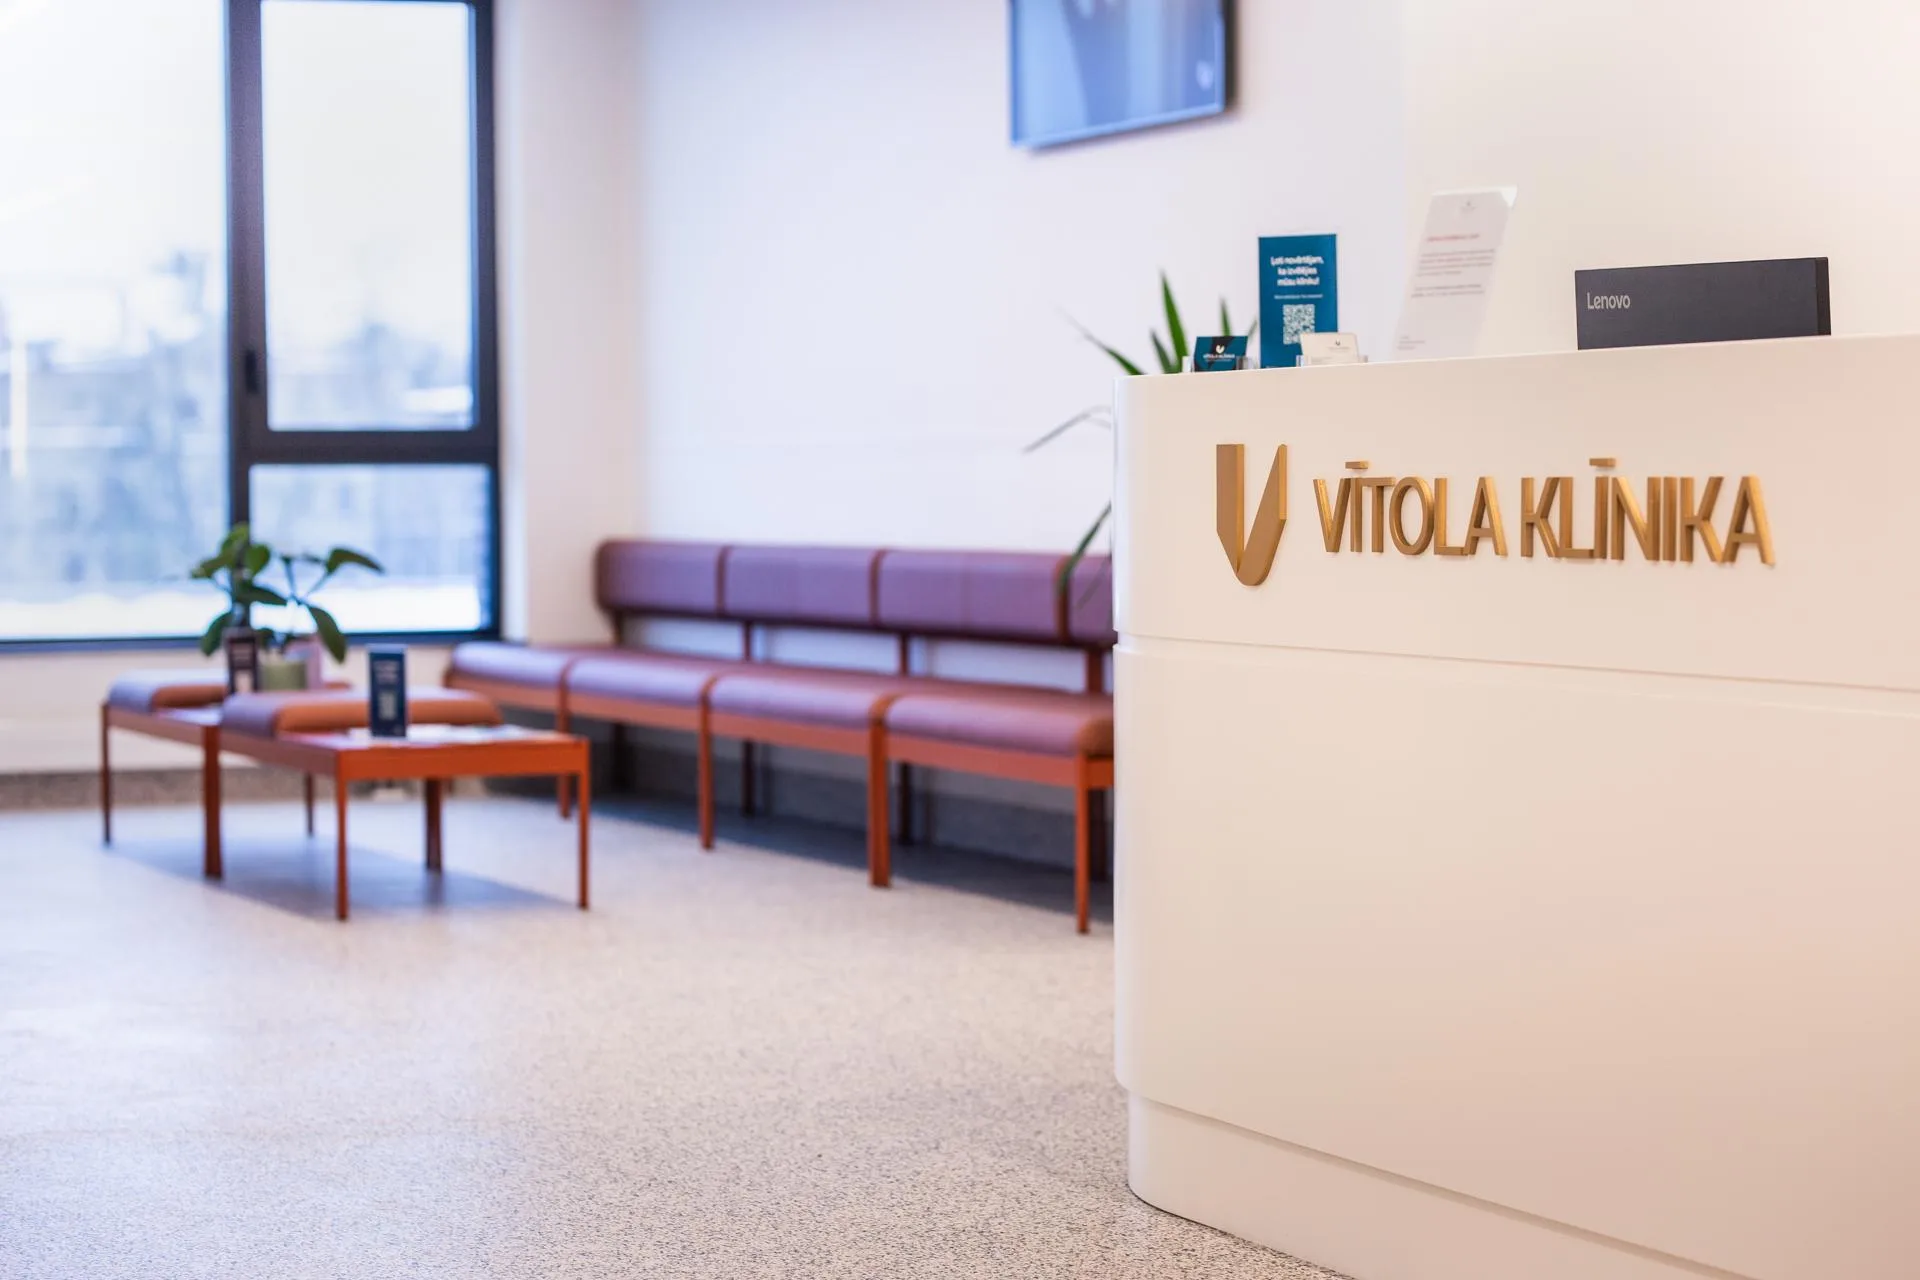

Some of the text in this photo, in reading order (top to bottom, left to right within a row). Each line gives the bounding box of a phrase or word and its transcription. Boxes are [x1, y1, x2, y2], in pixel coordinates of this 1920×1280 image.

[1587, 291, 1631, 309] Lenovo
[1313, 458, 1775, 565] VĪTOLA KLĪNIKA
